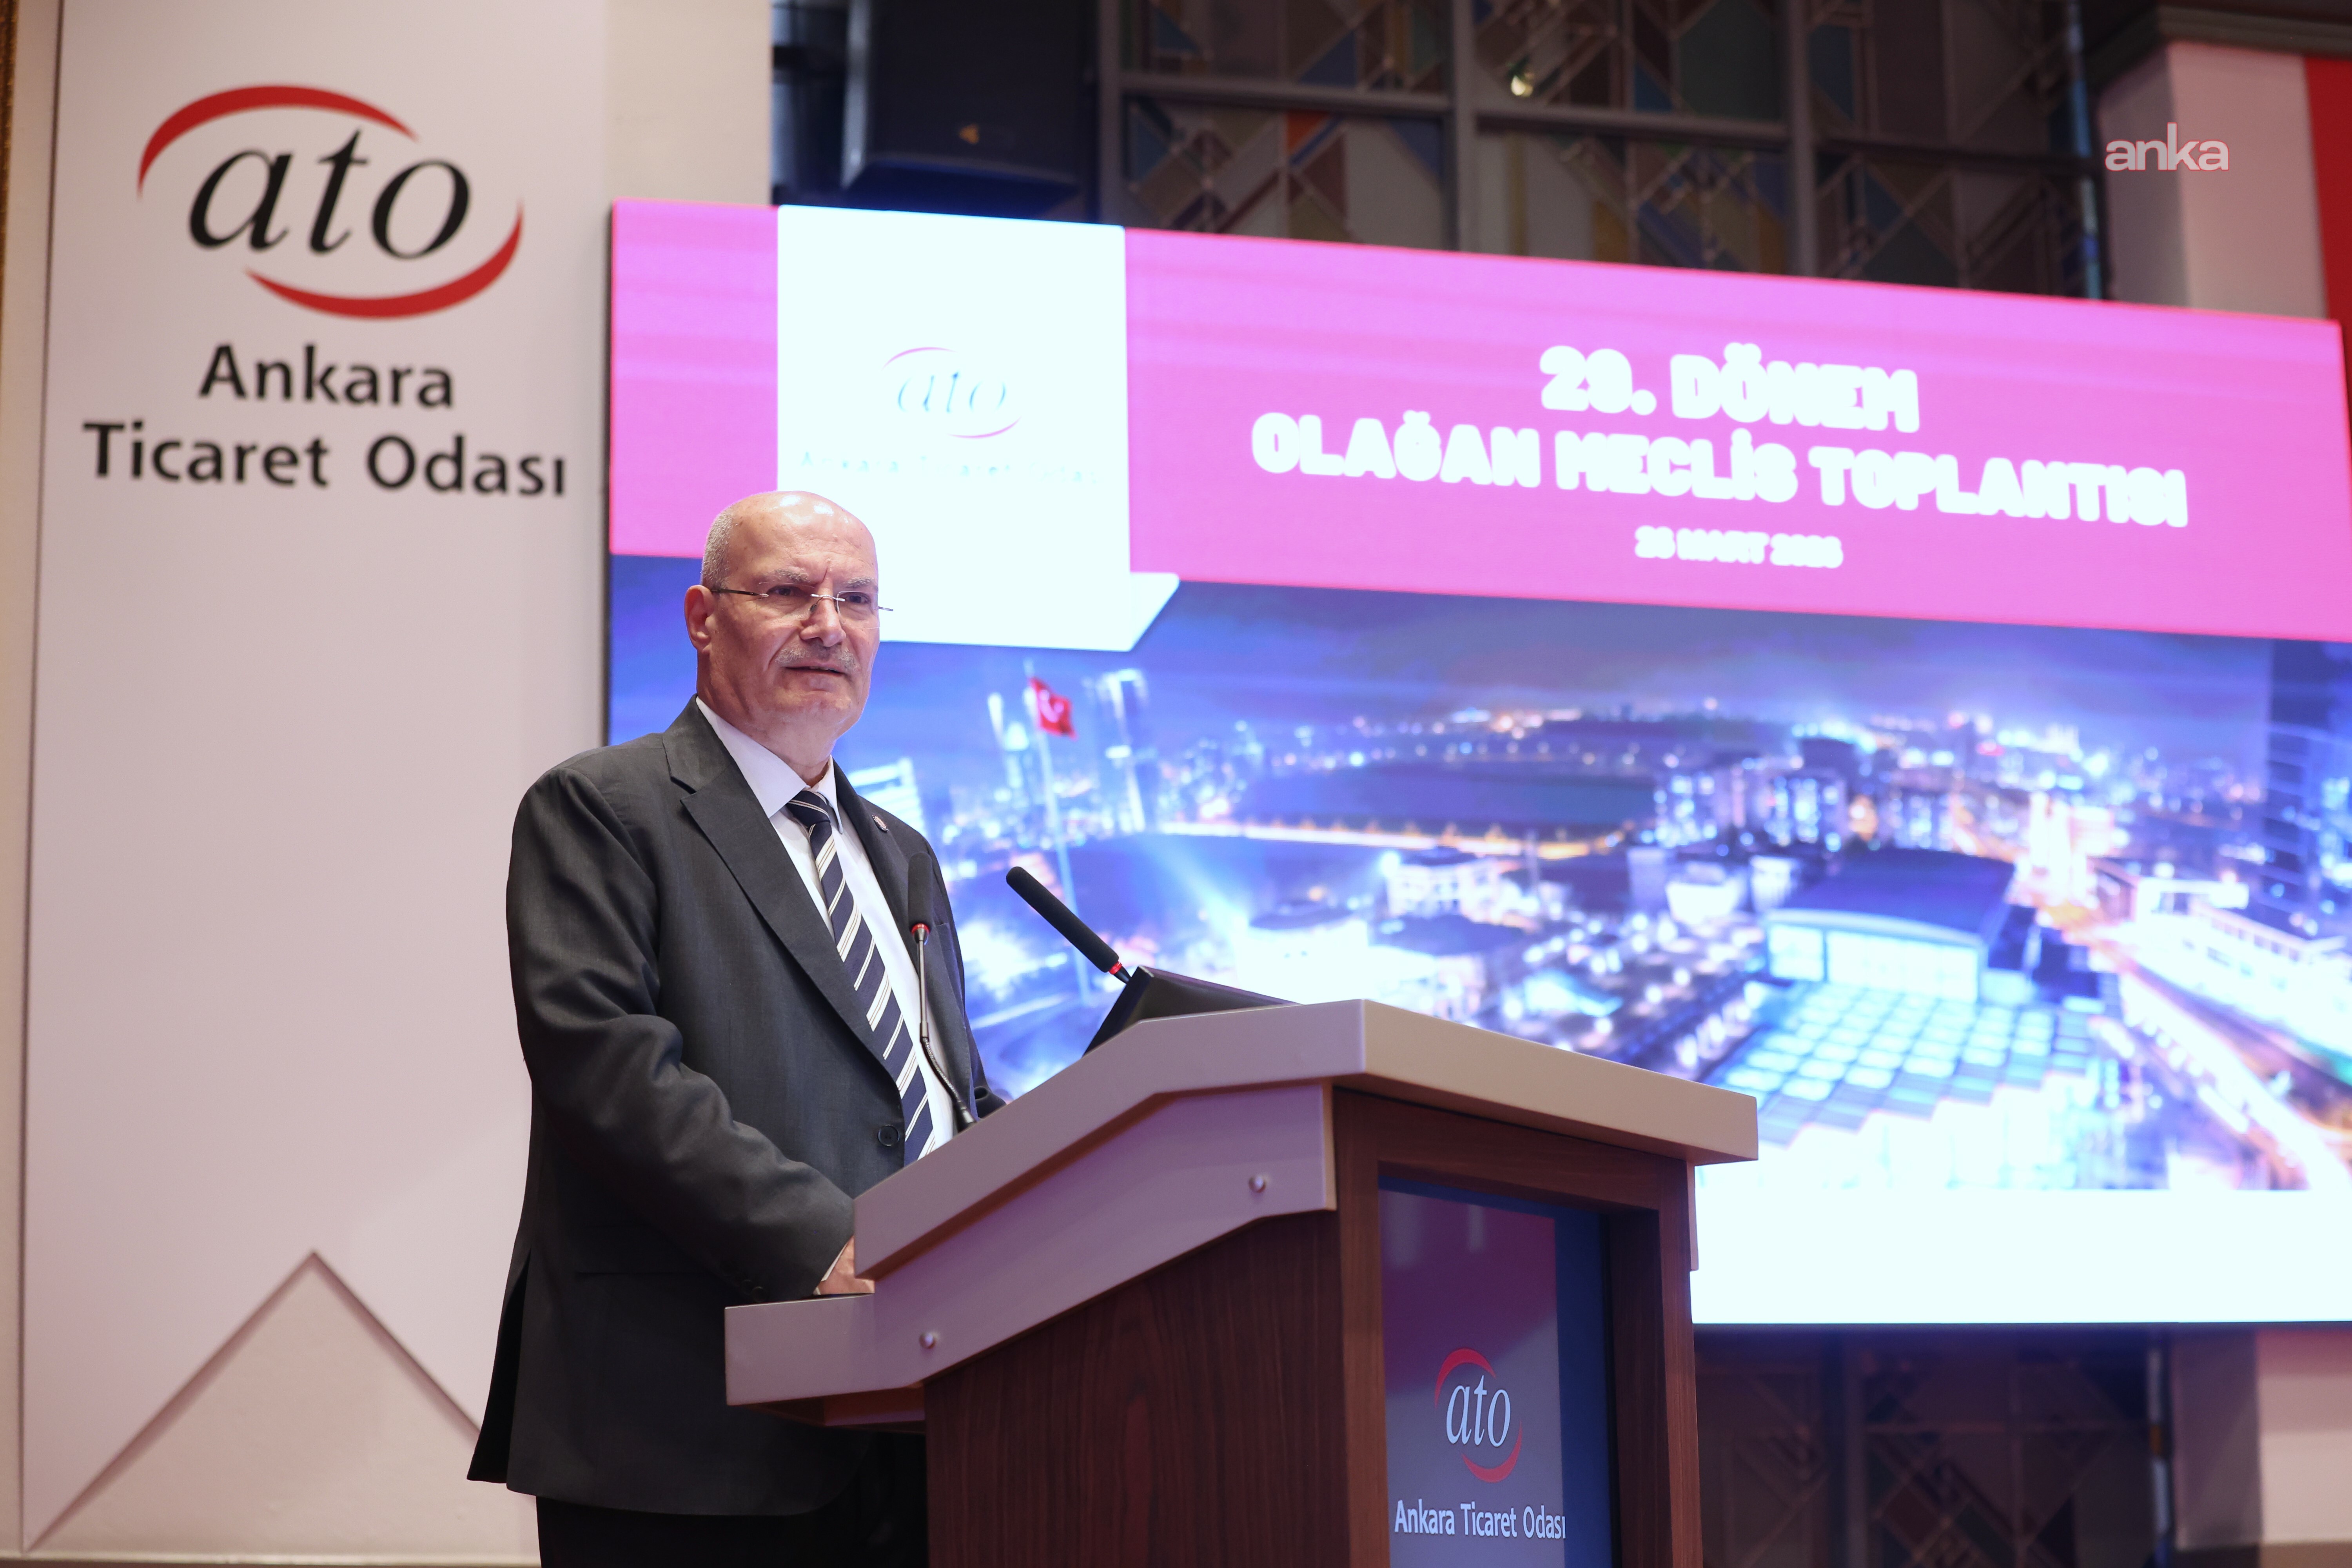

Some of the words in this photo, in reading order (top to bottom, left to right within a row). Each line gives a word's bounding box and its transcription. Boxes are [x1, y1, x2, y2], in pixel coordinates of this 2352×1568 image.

[189, 131, 470, 258] ato
[200, 343, 452, 408] Ankara
[1670, 342, 1920, 433] DÖNEM
[83, 419, 328, 487] Ticaret
[367, 434, 564, 496] Odası
[1251, 410, 1541, 488] OLAĞAN
[1554, 428, 1798, 503] MECLİS
[1808, 446, 2188, 528] TOPLANTISI
[1445, 1374, 1511, 1447] ato
[1394, 1498, 1455, 1535] Ankara
[1460, 1501, 1518, 1538] Ticaret
[1523, 1504, 1566, 1539] Odası
